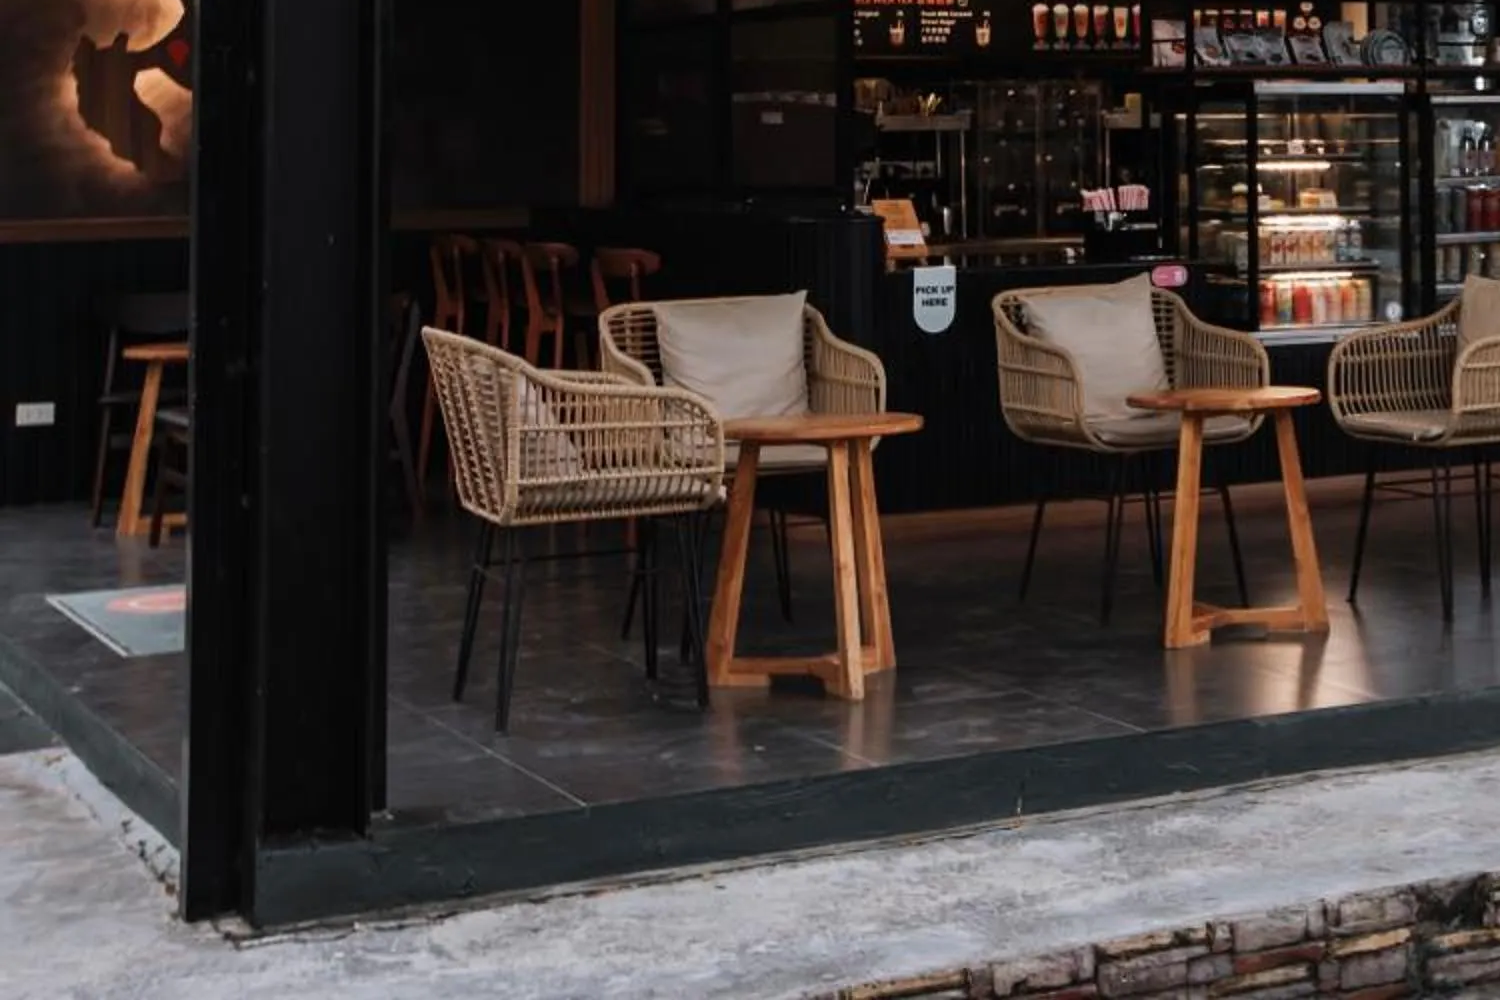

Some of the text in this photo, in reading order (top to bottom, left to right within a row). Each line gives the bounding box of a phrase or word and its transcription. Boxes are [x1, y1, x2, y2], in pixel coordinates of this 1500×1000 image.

[916, 285, 954, 294] PICK UP
[922, 297, 949, 307] HERE
